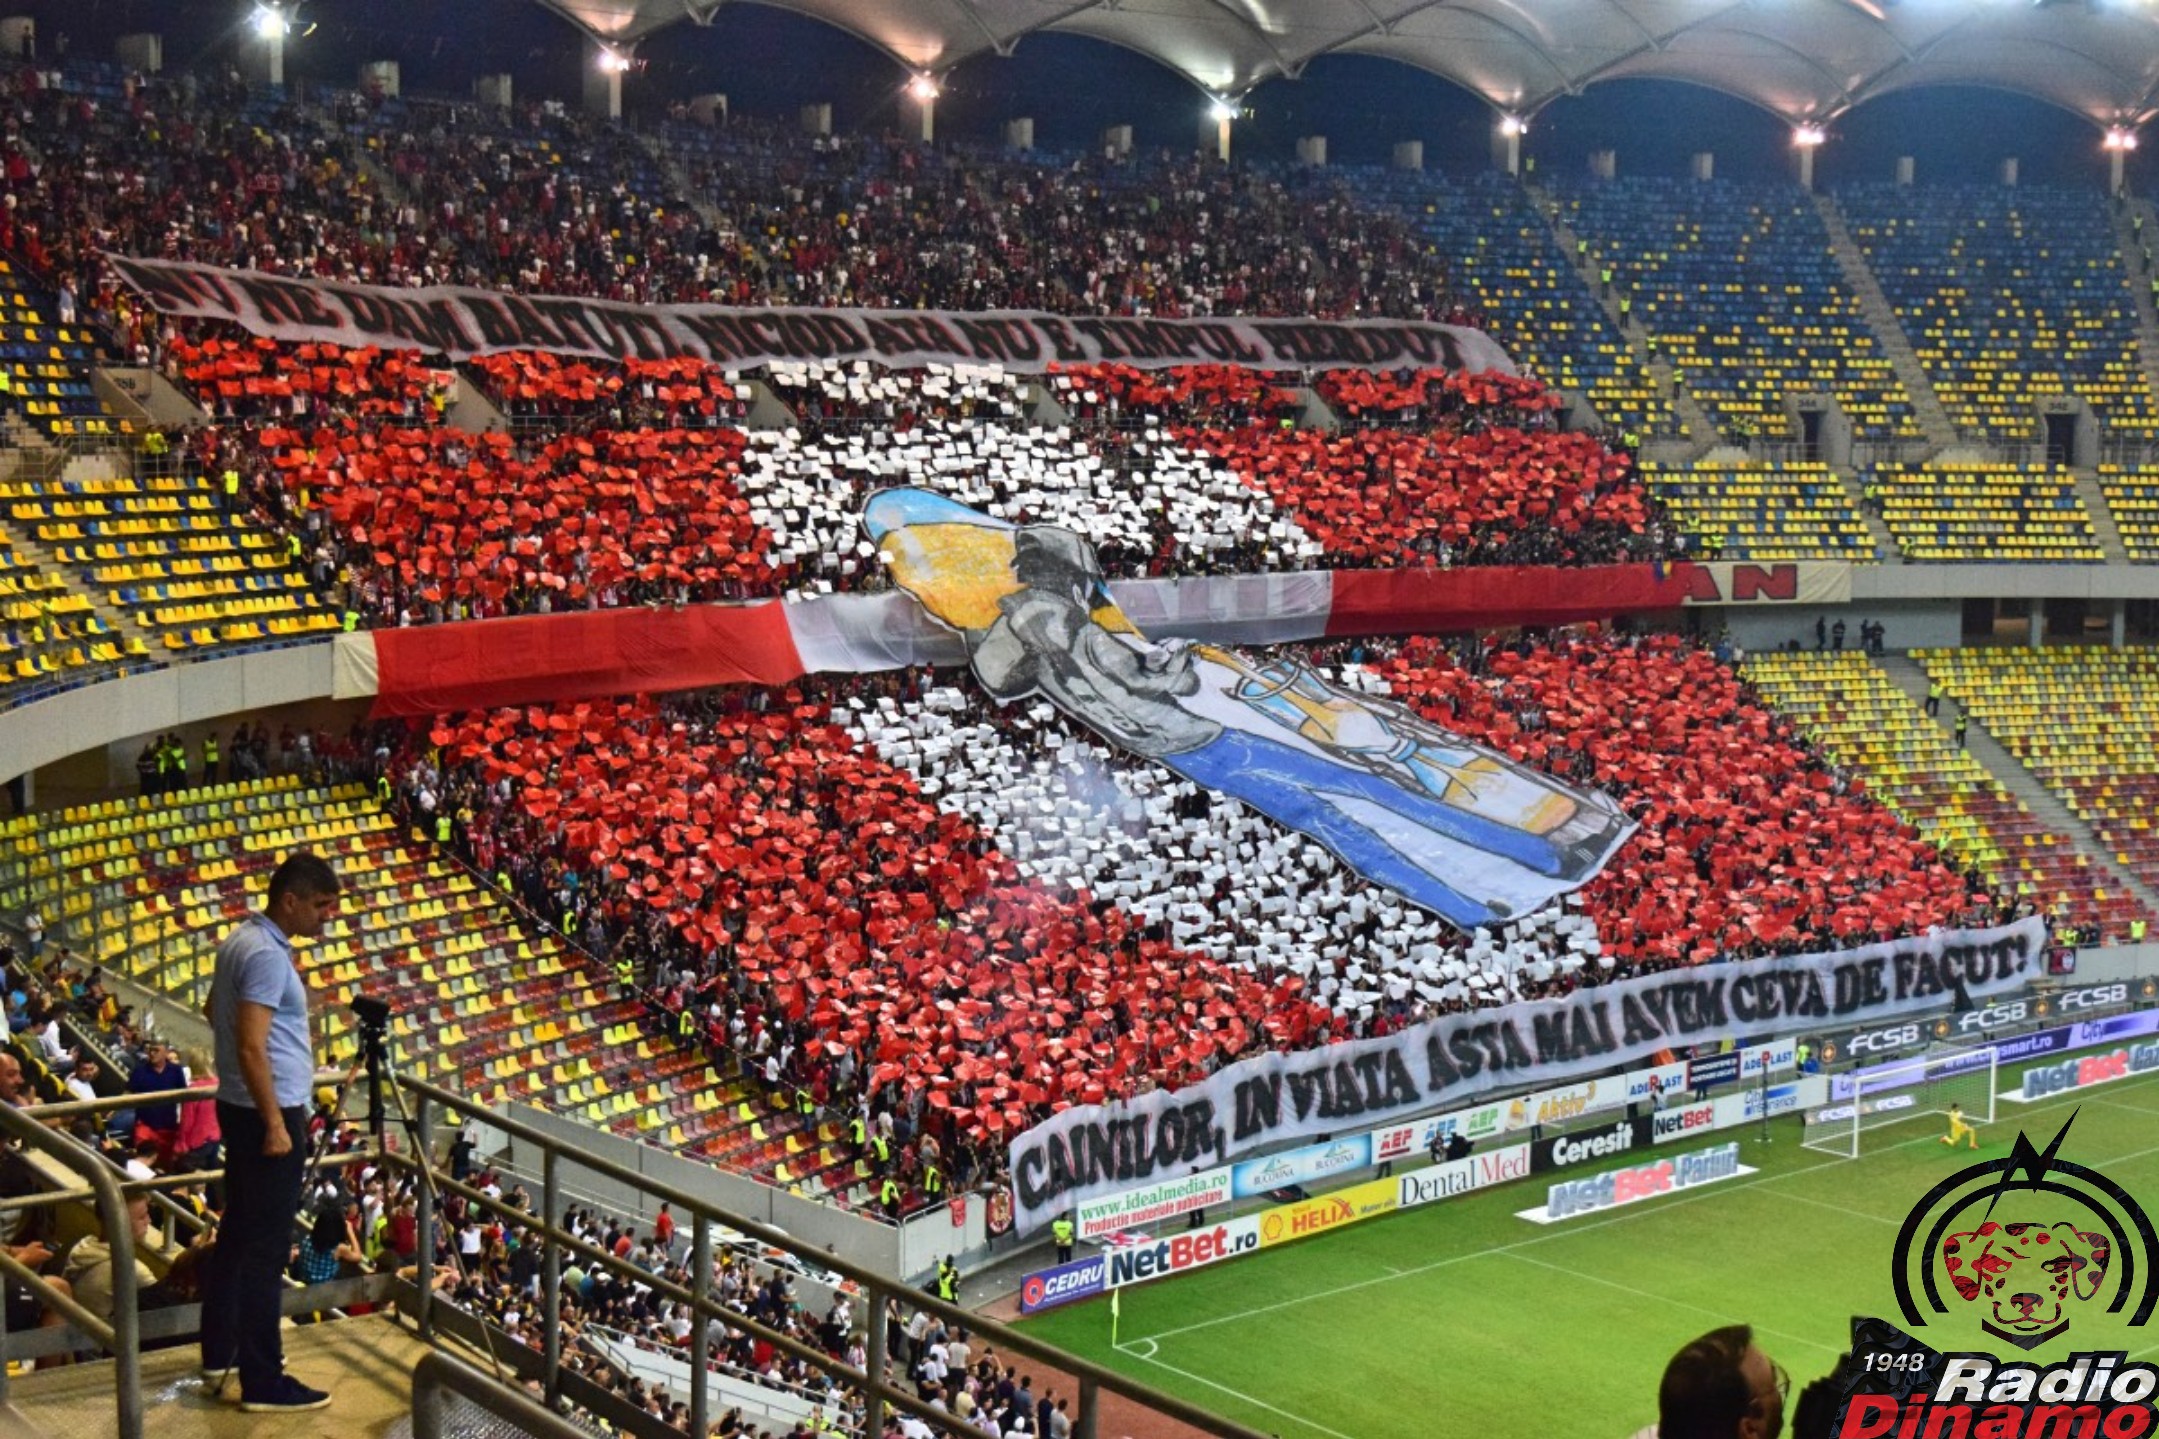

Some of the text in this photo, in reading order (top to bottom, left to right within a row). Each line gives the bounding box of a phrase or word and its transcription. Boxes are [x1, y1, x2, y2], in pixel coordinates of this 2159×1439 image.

[229, 275, 345, 329] NE
[327, 287, 482, 350] DAM
[953, 316, 1041, 362] NU
[1031, 317, 1088, 361] E
[1957, 1000, 2028, 1032] FCSB
[2058, 984, 2128, 1011] FCSB
[1846, 1023, 1920, 1056] FCSB
[1016, 1098, 1226, 1210] CAINILOR,
[1234, 1071, 1281, 1141] IN
[1286, 1047, 1421, 1122] VIATA
[1426, 1018, 1532, 1091] ASTA
[1532, 1001, 1618, 1065] MAI
[1622, 977, 1729, 1046] AVEM
[1730, 968, 1830, 1023] CEVA
[1832, 956, 1888, 1014] DE
[2023, 1048, 2129, 1099] NetBet
[1552, 1121, 1633, 1166] Ceresit
[1655, 1105, 1713, 1137] NetBet
[1081, 1174, 1228, 1220] www.idealmedia.ro
[1548, 1158, 1675, 1218] NetBet
[1292, 1201, 1354, 1234] HELIX
[1111, 1225, 1258, 1286] NetBet.ro
[1045, 1263, 1105, 1296] CEDRU
